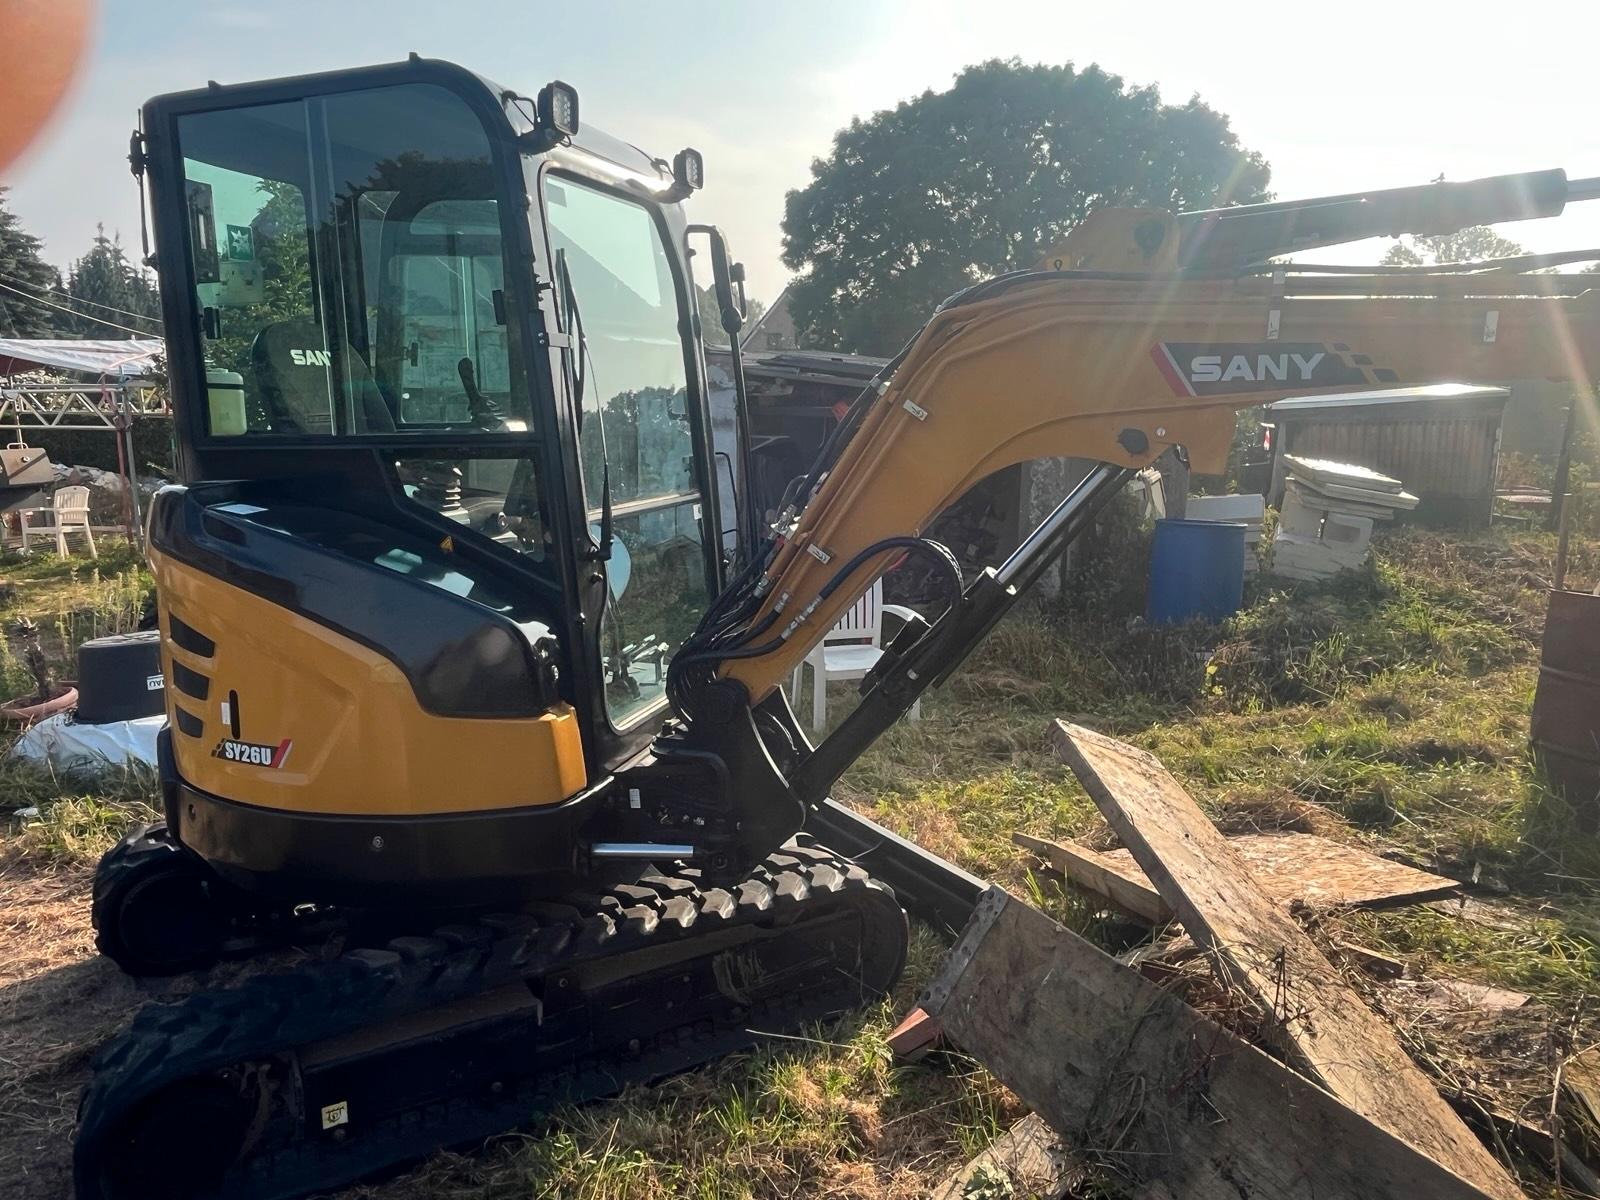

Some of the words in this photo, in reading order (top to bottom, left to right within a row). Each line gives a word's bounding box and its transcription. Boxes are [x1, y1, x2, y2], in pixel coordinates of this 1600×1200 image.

[290, 349, 331, 366] SAN
[1191, 353, 1325, 381] SANY
[225, 742, 272, 765] SY26U
